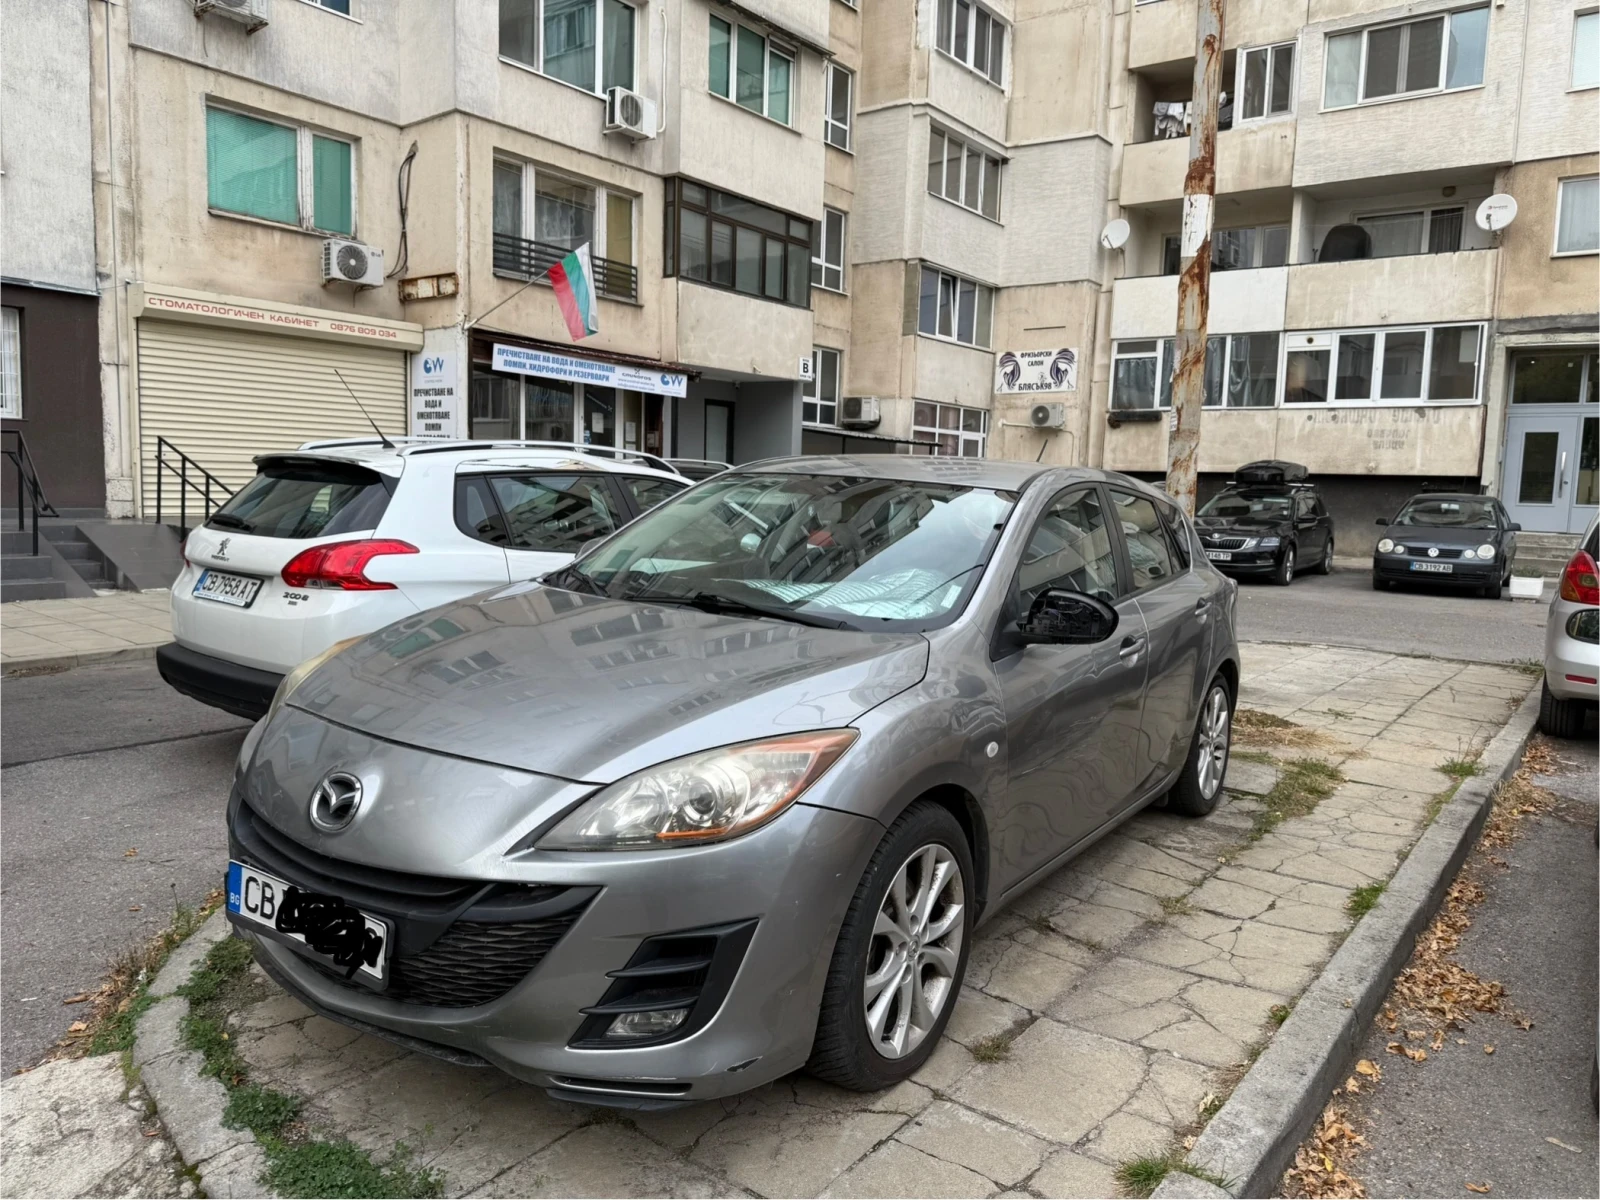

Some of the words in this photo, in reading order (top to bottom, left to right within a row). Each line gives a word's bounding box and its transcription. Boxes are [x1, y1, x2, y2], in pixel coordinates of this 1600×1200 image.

[148, 297, 264, 320] СТОМАТОЛОГИЧЕН
[270, 314, 319, 328] КАБИНЕТ
[330, 323, 355, 332] 0876
[357, 326, 376, 336] 809
[378, 329, 397, 338] 034
[497, 348, 542, 362] ПРЕЧИСТВАНЕ
[542, 355, 551, 363] НА
[552, 357, 568, 366] ВОДА
[574, 360, 616, 373] ОМЕКОТЯВАНЕ
[1020, 351, 1052, 359] ФРИЗЬОРСКИ
[528, 364, 567, 376] ХИДРОФОРИ
[574, 370, 610, 382] РЕЗЕРВОАРИ
[803, 362, 808, 373] В
[414, 388, 446, 397] ПРЕЧИСТВАНЕ
[447, 388, 454, 396] НА
[1018, 383, 1052, 391] БЛЯСЪК98
[425, 400, 437, 409] ВОДА
[438, 400, 442, 408] И
[417, 412, 450, 420] ОМЕКОТЯВАНЕ
[425, 423, 441, 431] ПОМПИ
[202, 574, 218, 591] CB
[214, 576, 242, 596] 7958
[237, 580, 258, 600] AT
[230, 892, 240, 905] BG
[244, 876, 275, 920] CB
